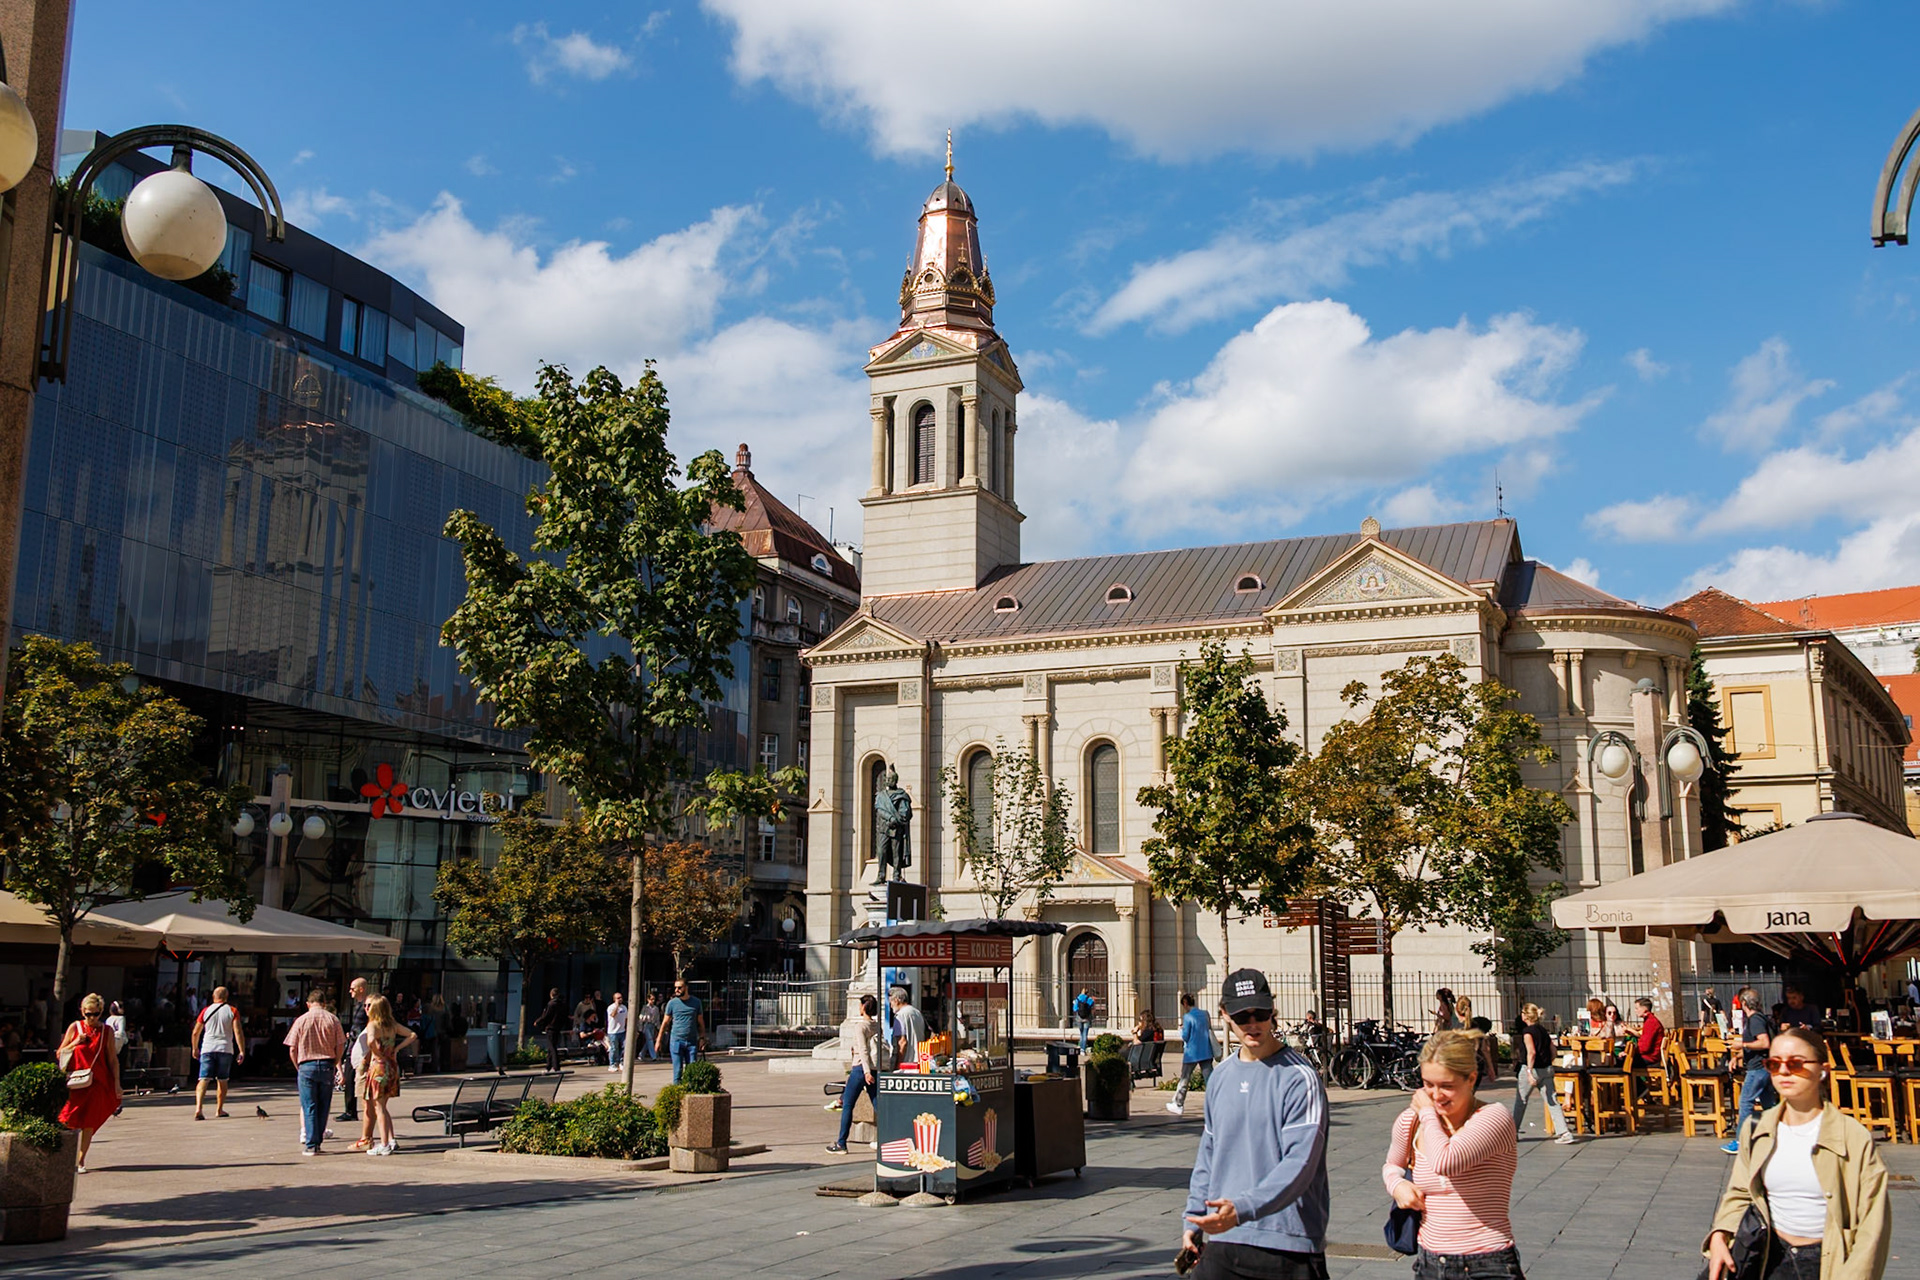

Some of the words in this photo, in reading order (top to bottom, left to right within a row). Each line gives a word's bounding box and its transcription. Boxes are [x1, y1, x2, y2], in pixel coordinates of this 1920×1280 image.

[1585, 903, 1633, 923] Bonita
[886, 942, 946, 957] KOKICE
[970, 942, 1000, 958] KOKICE
[887, 1079, 943, 1092] POPCORN
